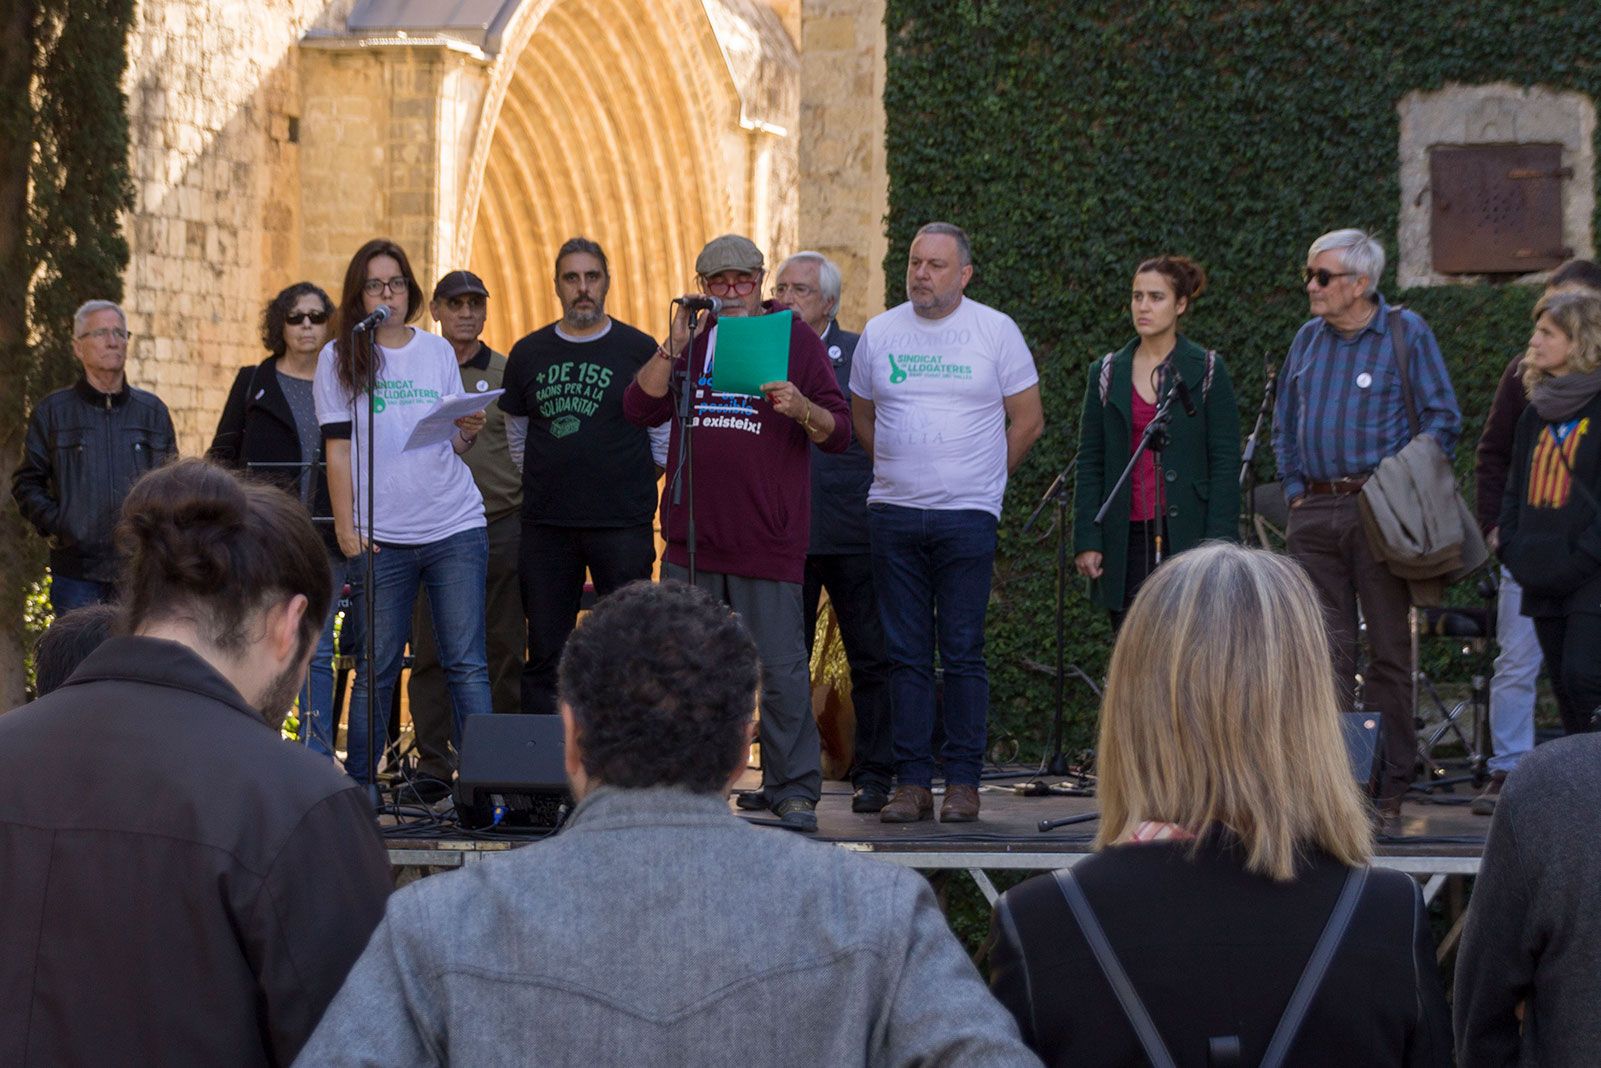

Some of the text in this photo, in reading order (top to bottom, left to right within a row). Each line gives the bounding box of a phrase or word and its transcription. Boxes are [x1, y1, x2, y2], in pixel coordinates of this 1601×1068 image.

[897, 354, 943, 364] SINDICAT
[548, 362, 574, 384] DE
[579, 362, 614, 388] 155
[907, 364, 973, 375] LLOGATERES
[374, 380, 414, 389] INDICAT
[384, 389, 439, 399] LLOGATERES
[564, 383, 582, 394] PER
[584, 385, 590, 397] A
[592, 388, 604, 402] LA
[540, 397, 599, 417] SOLIDARITAT
[703, 416, 762, 435] existeix!
